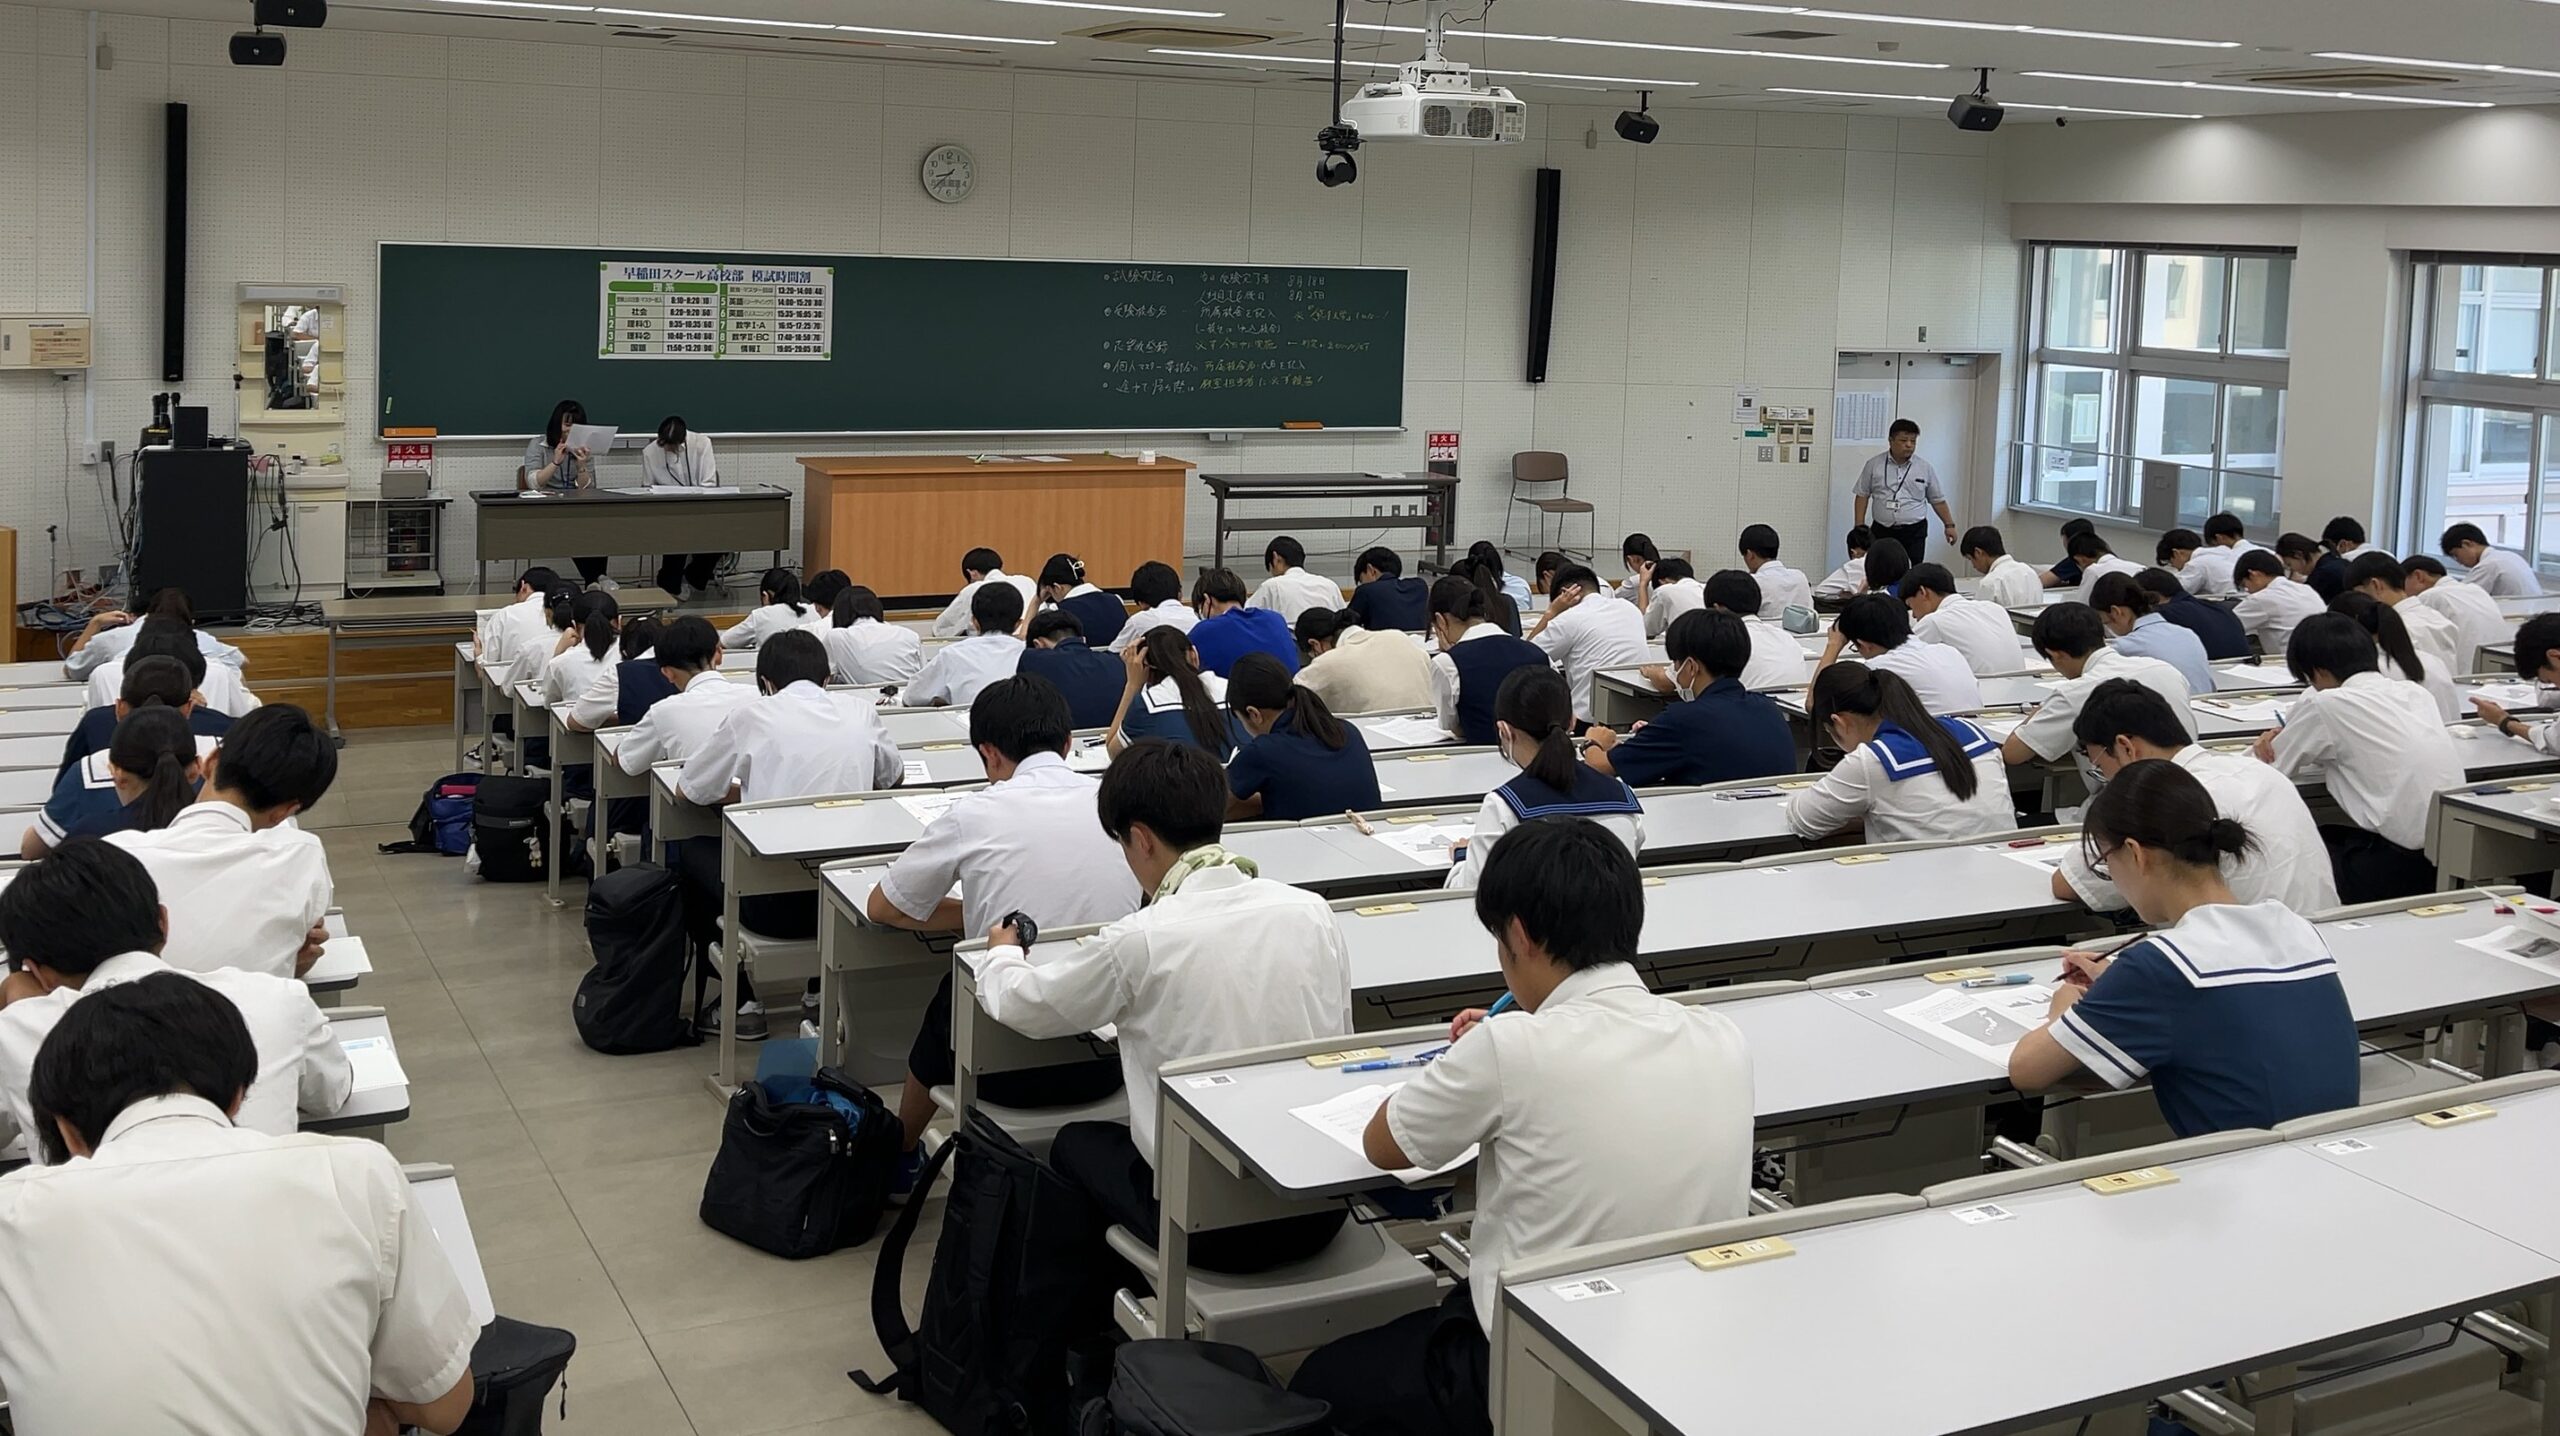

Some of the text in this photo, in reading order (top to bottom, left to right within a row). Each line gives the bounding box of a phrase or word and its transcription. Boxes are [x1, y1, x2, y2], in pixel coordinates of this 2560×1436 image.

[624, 267, 812, 284] 早稲田スクール高校部 模試時間割
[631, 308, 648, 316] 社会
[608, 320, 614, 328] 2
[627, 320, 652, 328] 理科①
[720, 321, 725, 329] 7
[608, 332, 614, 340] 3
[627, 332, 651, 340] 理科②
[720, 333, 726, 341] 8
[630, 344, 647, 352] 国語
[391, 445, 429, 454] 消火器
